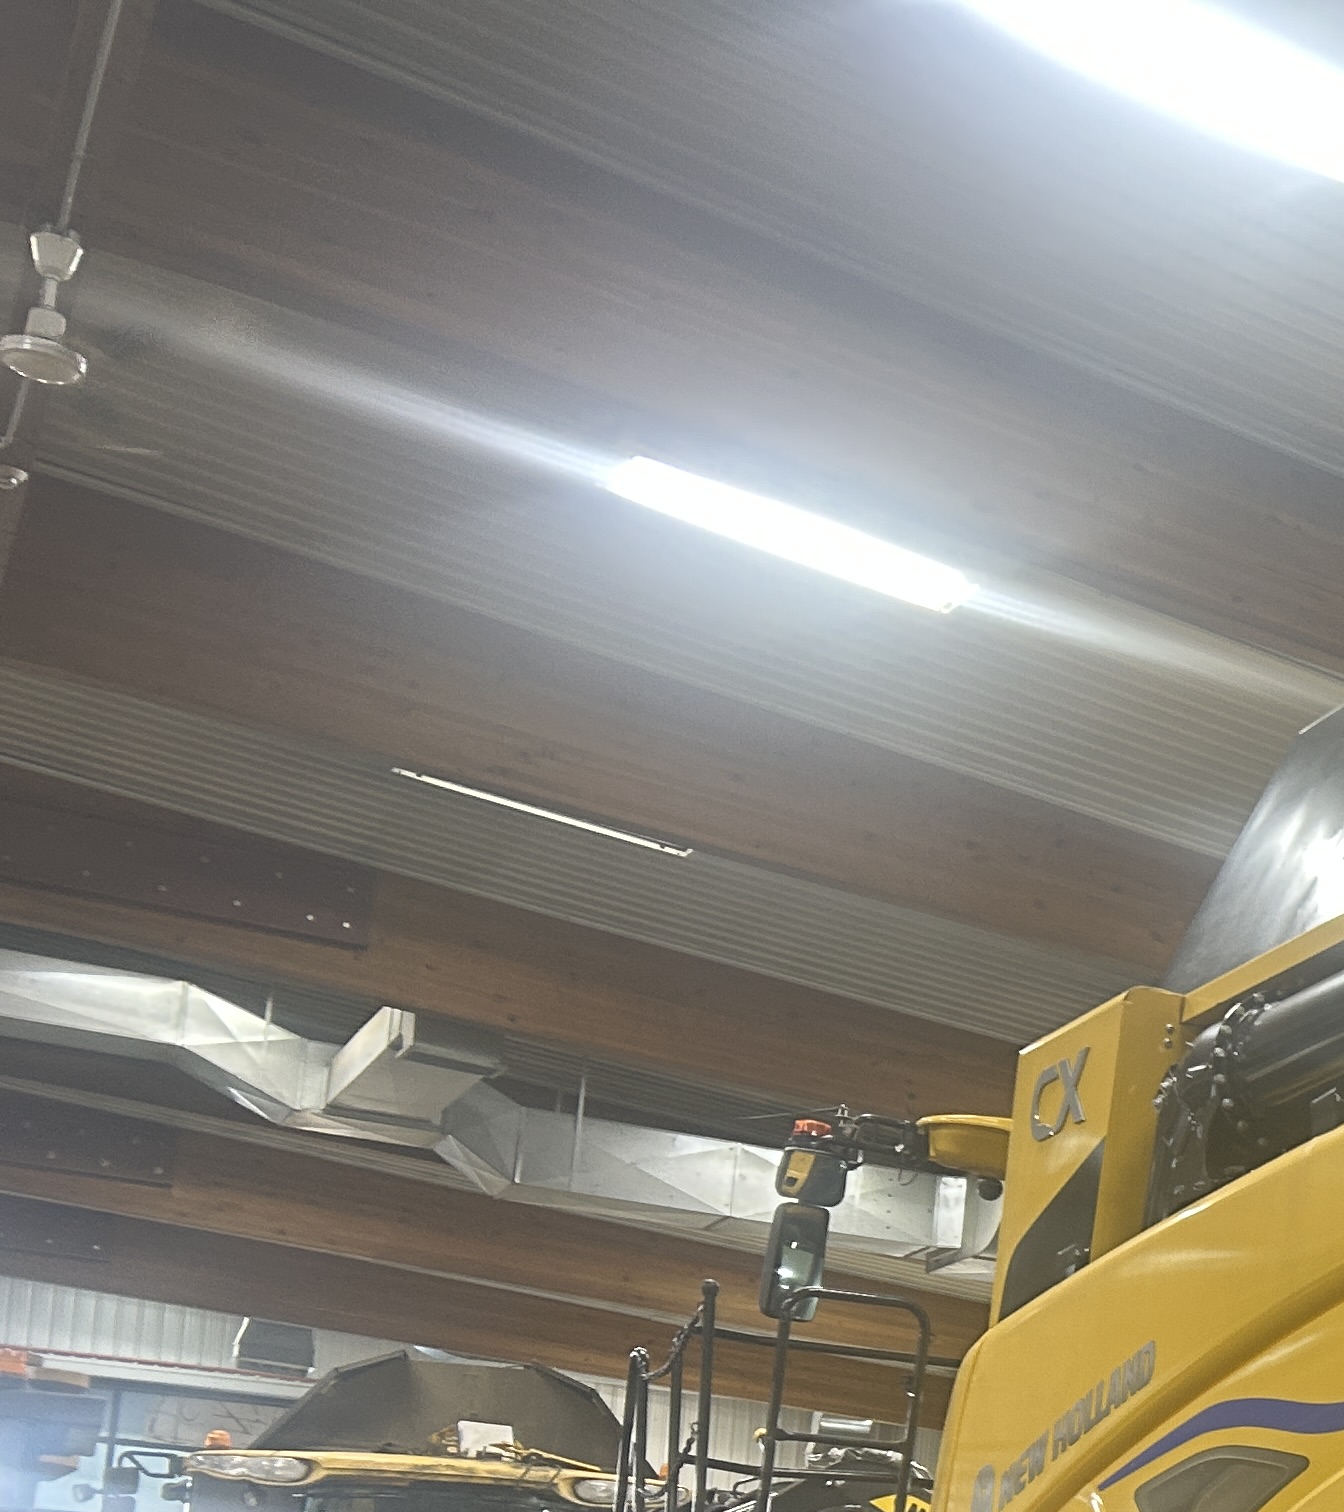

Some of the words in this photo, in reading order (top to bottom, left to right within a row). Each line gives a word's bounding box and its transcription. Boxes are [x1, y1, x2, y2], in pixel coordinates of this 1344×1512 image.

[1030, 1046, 1091, 1142] CX
[998, 1428, 1049, 1512] NEW
[1052, 1340, 1156, 1461] HOLLAND
